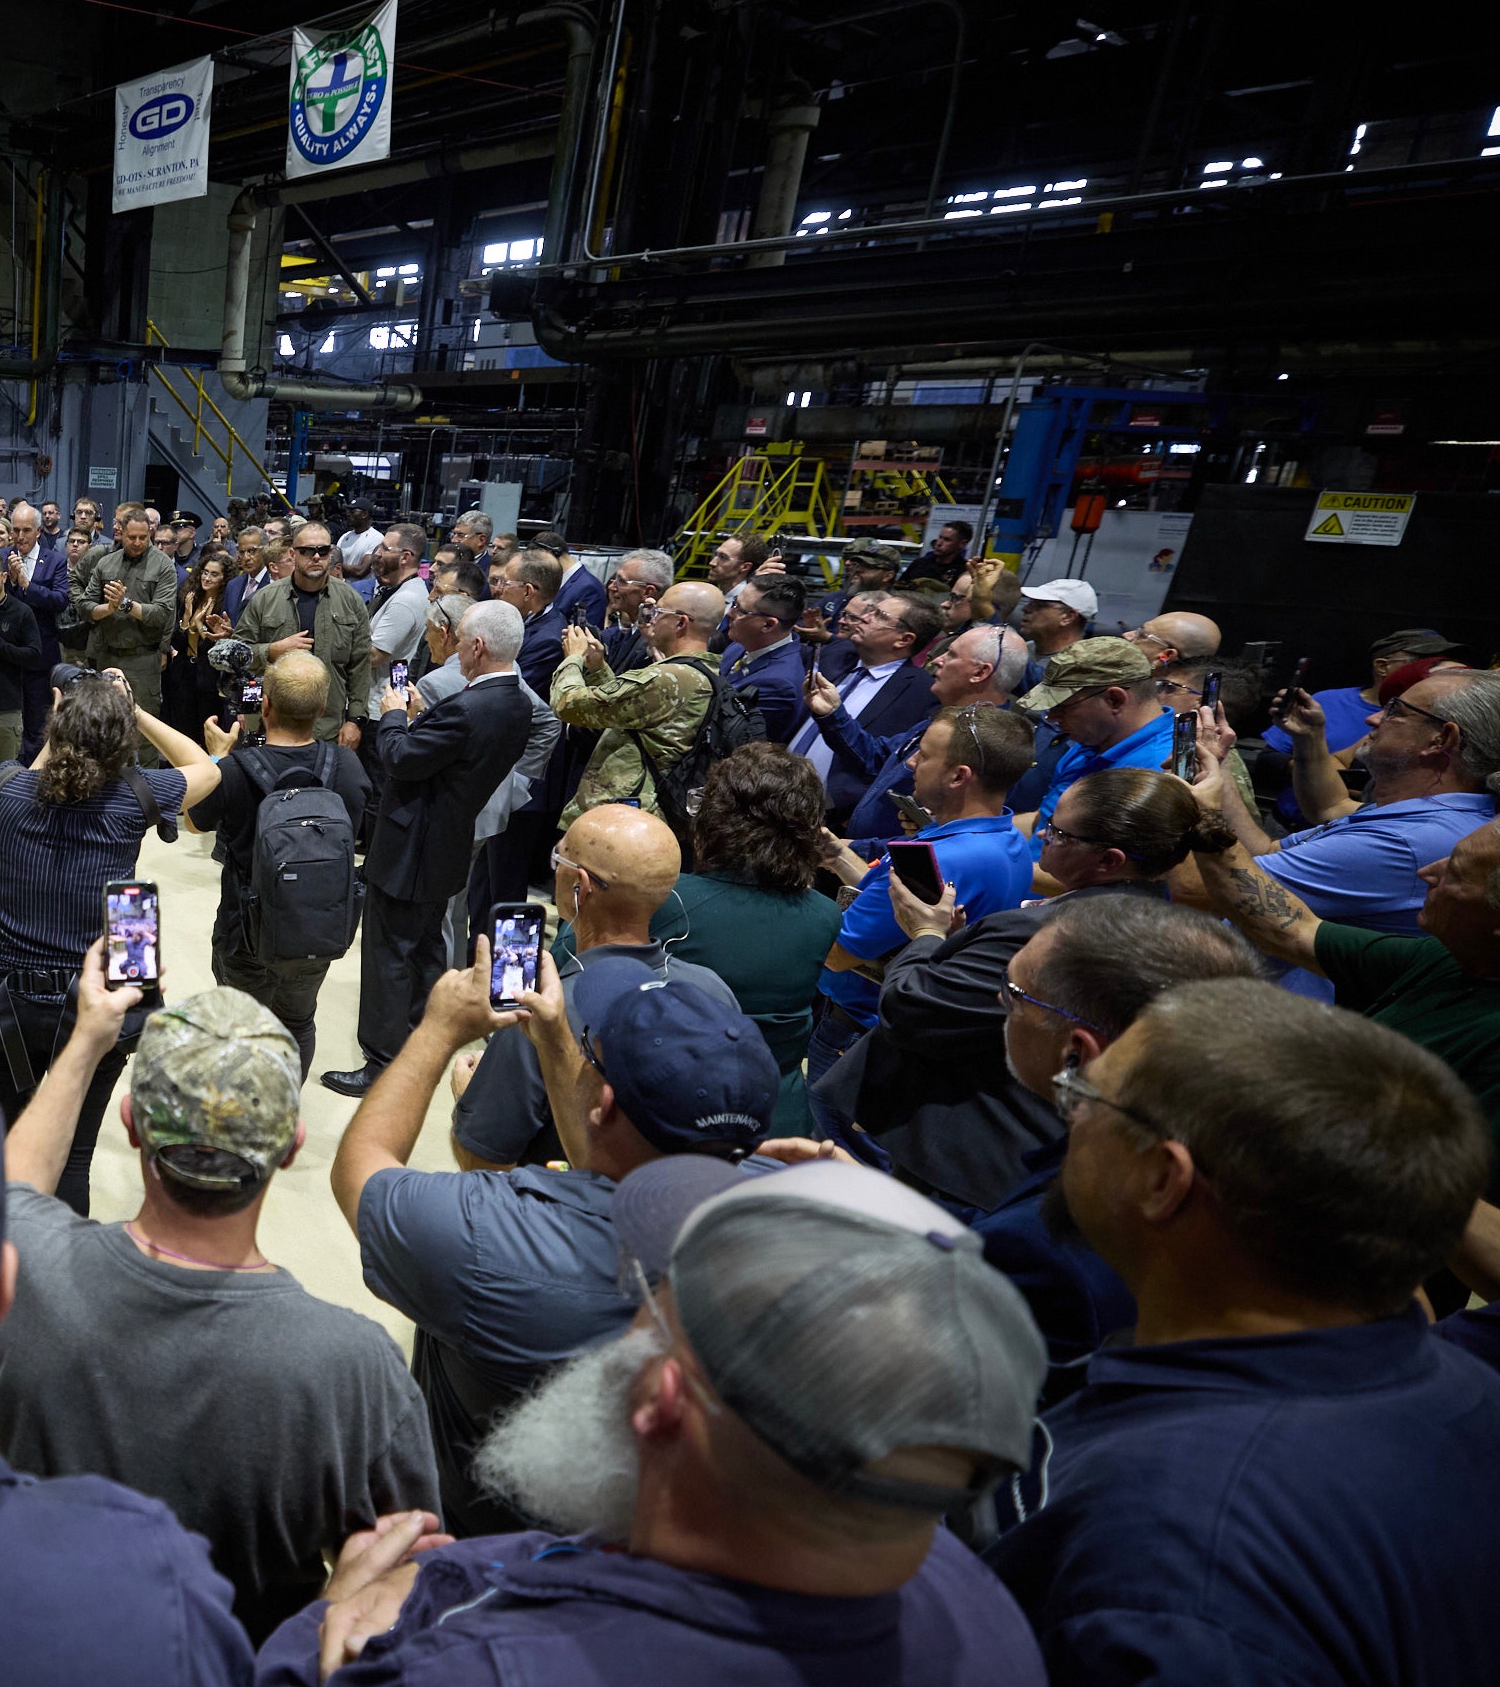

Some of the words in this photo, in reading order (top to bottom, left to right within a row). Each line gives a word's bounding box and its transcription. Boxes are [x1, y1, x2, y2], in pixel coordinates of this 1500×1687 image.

[140, 77, 186, 98] Transparency
[136, 99, 187, 134] GD
[295, 112, 330, 156] QUALITY
[333, 90, 377, 154] ALWAYS
[118, 104, 130, 151] Honesty
[142, 139, 175, 157] Alignment
[190, 157, 200, 169] PA
[127, 179, 166, 195] MANUFACTURE
[1343, 496, 1407, 511] CAUTION
